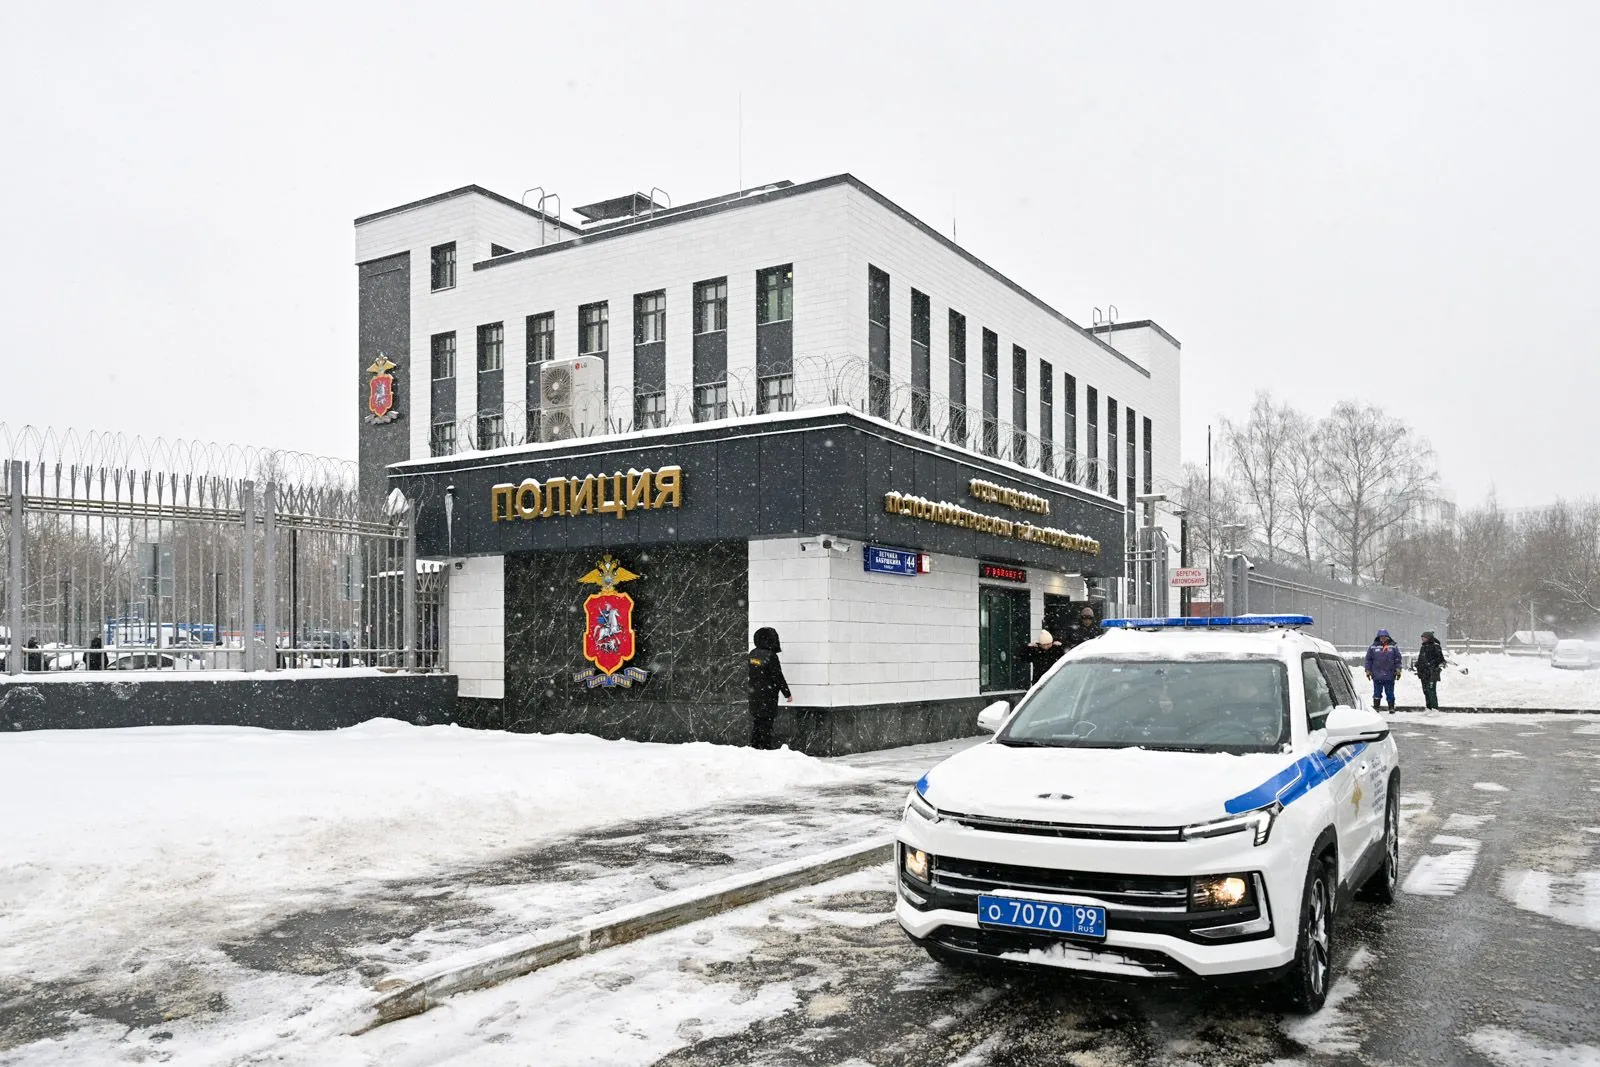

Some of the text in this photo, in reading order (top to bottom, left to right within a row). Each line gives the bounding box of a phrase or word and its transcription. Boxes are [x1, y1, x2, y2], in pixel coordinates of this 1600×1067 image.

[491, 466, 681, 522] ПОЛИЦИЯ
[906, 556, 915, 568] 44
[1009, 902, 1061, 927] 7070
[1075, 908, 1097, 926] 99
[1078, 925, 1094, 933] RUS
